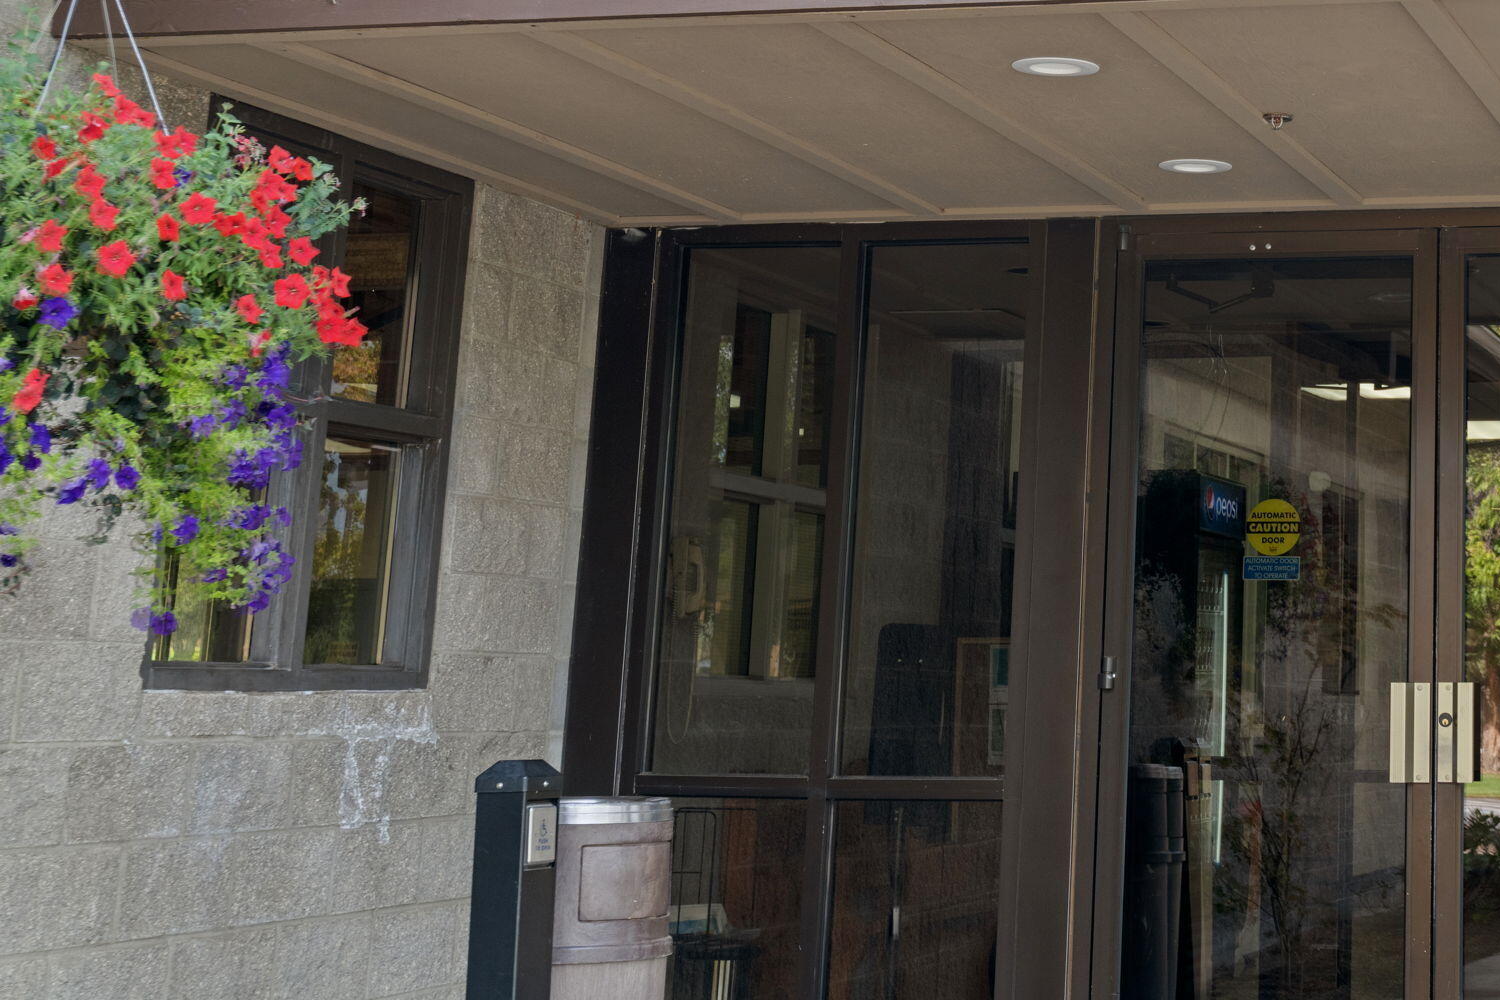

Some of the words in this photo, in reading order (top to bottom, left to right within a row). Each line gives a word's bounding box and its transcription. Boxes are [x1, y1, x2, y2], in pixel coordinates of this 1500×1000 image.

[1216, 496, 1238, 523] pepsi
[1251, 511, 1297, 519] AUTOMATIC
[1249, 522, 1299, 532] CAUTION
[1261, 536, 1285, 544] DOOR
